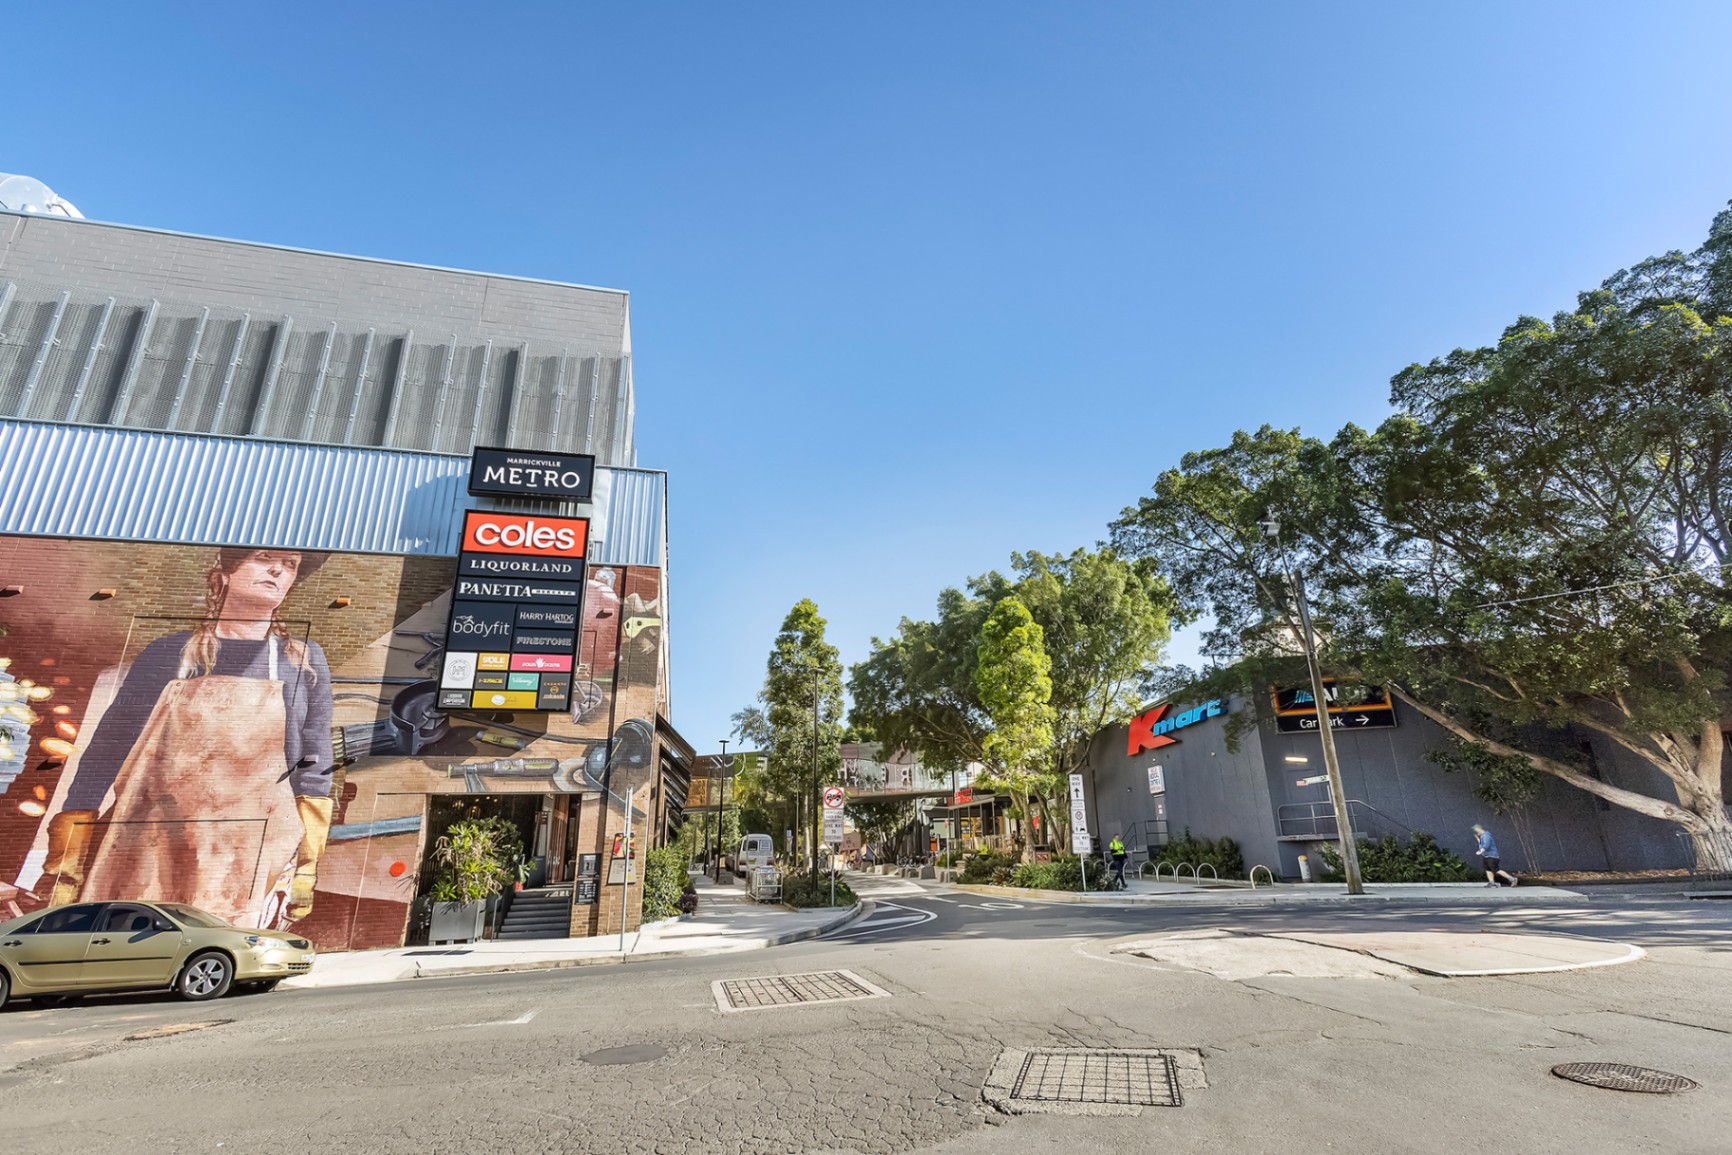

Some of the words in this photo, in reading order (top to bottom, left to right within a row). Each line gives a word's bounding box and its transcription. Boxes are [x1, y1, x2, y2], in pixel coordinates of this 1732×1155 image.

[506, 457, 561, 467] MARRICKVILLE
[482, 465, 581, 488] METRO
[475, 520, 576, 550] coles
[470, 559, 572, 573] LIQUORLAND
[459, 582, 532, 597] PANETTA
[519, 611, 545, 621] HARRY
[545, 612, 574, 622] HARTOG
[452, 618, 511, 638] bodyfit
[516, 636, 572, 646] FIRESTONE
[1299, 718, 1318, 729] Car
[1327, 716, 1346, 727] ark
